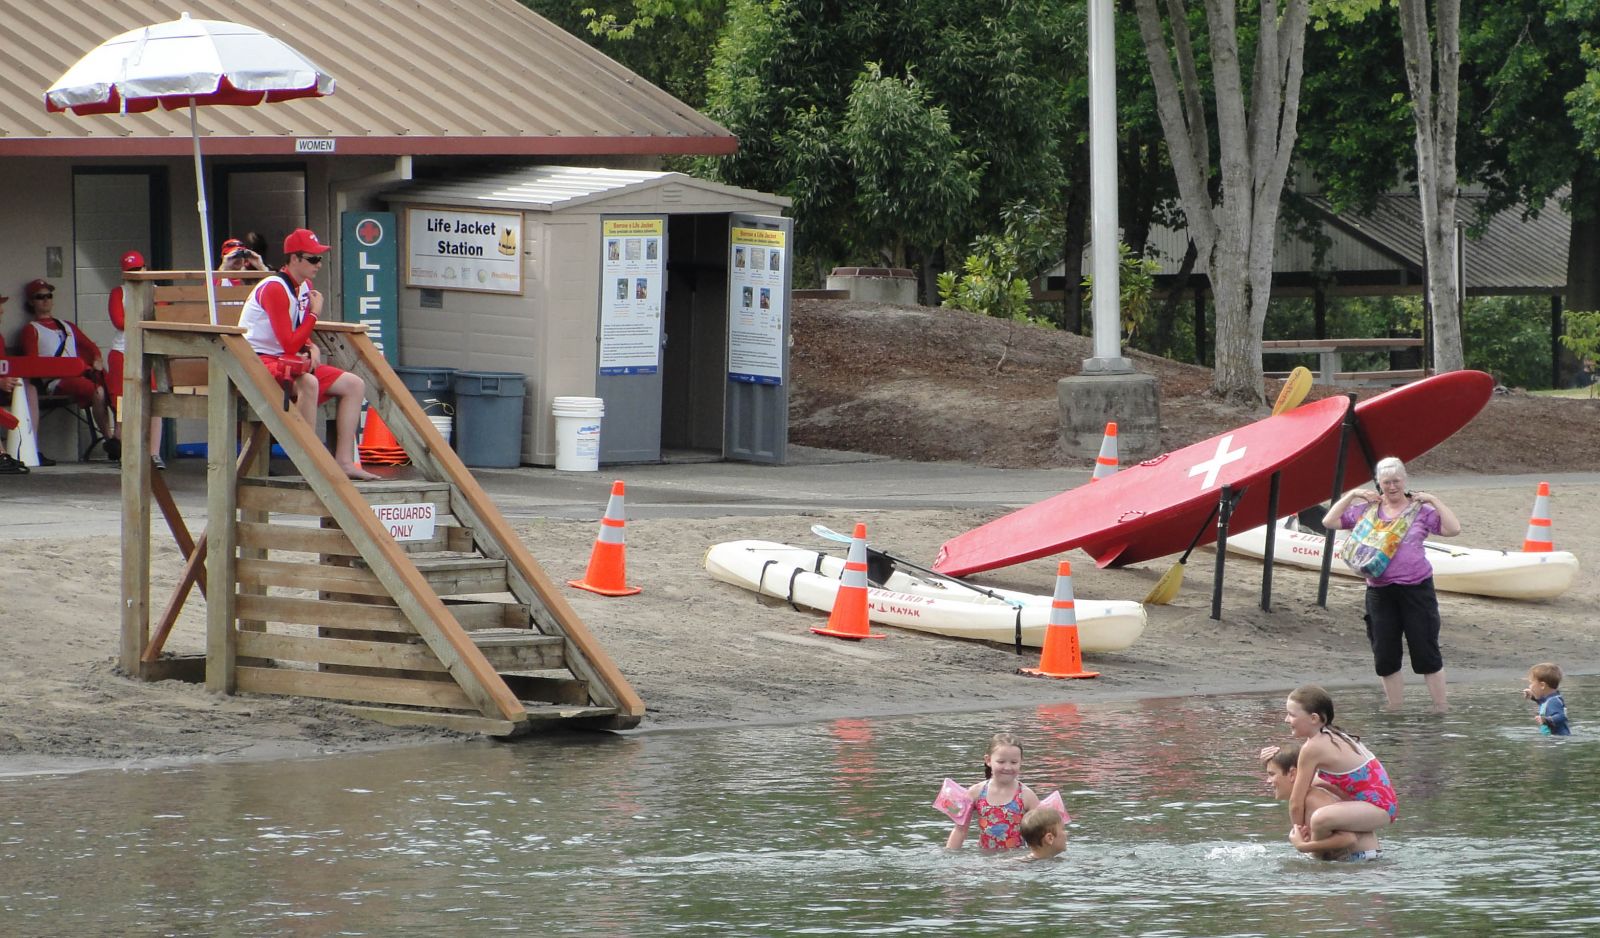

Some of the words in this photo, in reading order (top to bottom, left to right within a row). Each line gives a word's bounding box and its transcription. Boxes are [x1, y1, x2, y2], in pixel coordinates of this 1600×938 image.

[299, 140, 332, 150] WOMEN
[427, 218, 451, 232] Life
[454, 220, 496, 235] Jacket
[438, 240, 483, 256] Station
[372, 506, 432, 520] IFEGUARDS
[390, 525, 414, 538] ONLY
[1292, 546, 1320, 556] OCEAN
[889, 606, 921, 617] KAYAK
